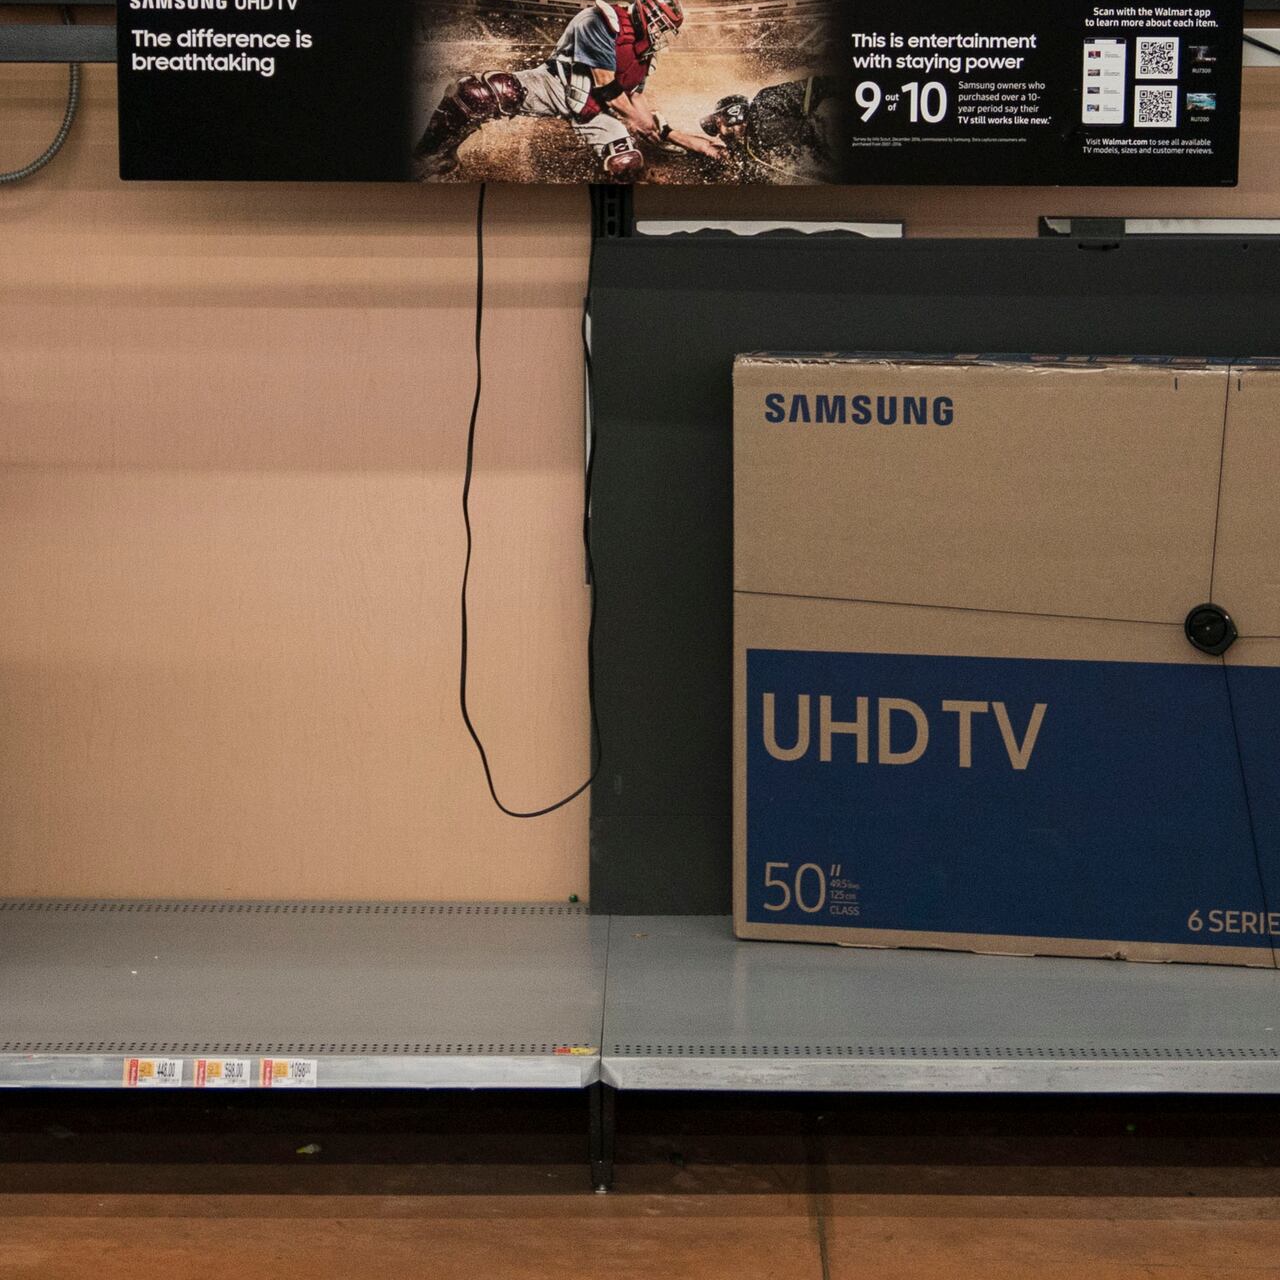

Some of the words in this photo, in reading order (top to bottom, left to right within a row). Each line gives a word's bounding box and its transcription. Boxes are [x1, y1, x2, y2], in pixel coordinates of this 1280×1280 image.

[1093, 7, 1114, 16] Scan
[1116, 7, 1136, 16] with
[1138, 7, 1153, 16] the
[1154, 8, 1192, 17] Walmart
[1194, 9, 1211, 18] app
[1085, 18, 1095, 27] to
[1096, 18, 1119, 27] learn
[1121, 19, 1144, 27] more
[1146, 18, 1171, 27] about
[1173, 18, 1194, 27] each
[1195, 18, 1219, 28] item.
[131, 30, 171, 48] The
[176, 29, 291, 49] difference
[295, 30, 313, 48] is
[851, 33, 886, 48] This
[890, 33, 904, 48] is
[907, 33, 1037, 49] entertainment
[131, 53, 276, 76] breathtaking
[853, 53, 892, 69] with
[896, 53, 961, 73] staying
[965, 57, 1024, 73] power
[958, 81, 995, 90] Samsung
[997, 82, 1026, 90] owners
[1028, 81, 1046, 89] who
[854, 81, 882, 123] 9
[885, 94, 900, 102] out
[901, 81, 948, 123] 10
[958, 93, 1000, 103] purchased
[1028, 93, 1041, 101] 10-
[887, 103, 897, 111] of
[977, 105, 1003, 113] period
[1020, 104, 1039, 112] their
[958, 116, 969, 124] TV
[970, 116, 986, 124] still
[987, 116, 1012, 124] works
[1014, 116, 1029, 124] like
[1085, 138, 1101, 146] Visit
[1102, 138, 1148, 146] Walmart.com
[1149, 138, 1156, 146] to
[1171, 138, 1180, 146] all
[1181, 138, 1211, 146] available
[1082, 146, 1092, 154] TV
[1093, 146, 1120, 155] models,
[1139, 146, 1151, 154] and
[764, 393, 954, 426] SAMSUNG
[762, 692, 928, 765] UHD
[942, 700, 1048, 771] TV
[830, 905, 860, 916] CLASS
[1186, 910, 1204, 933] 6
